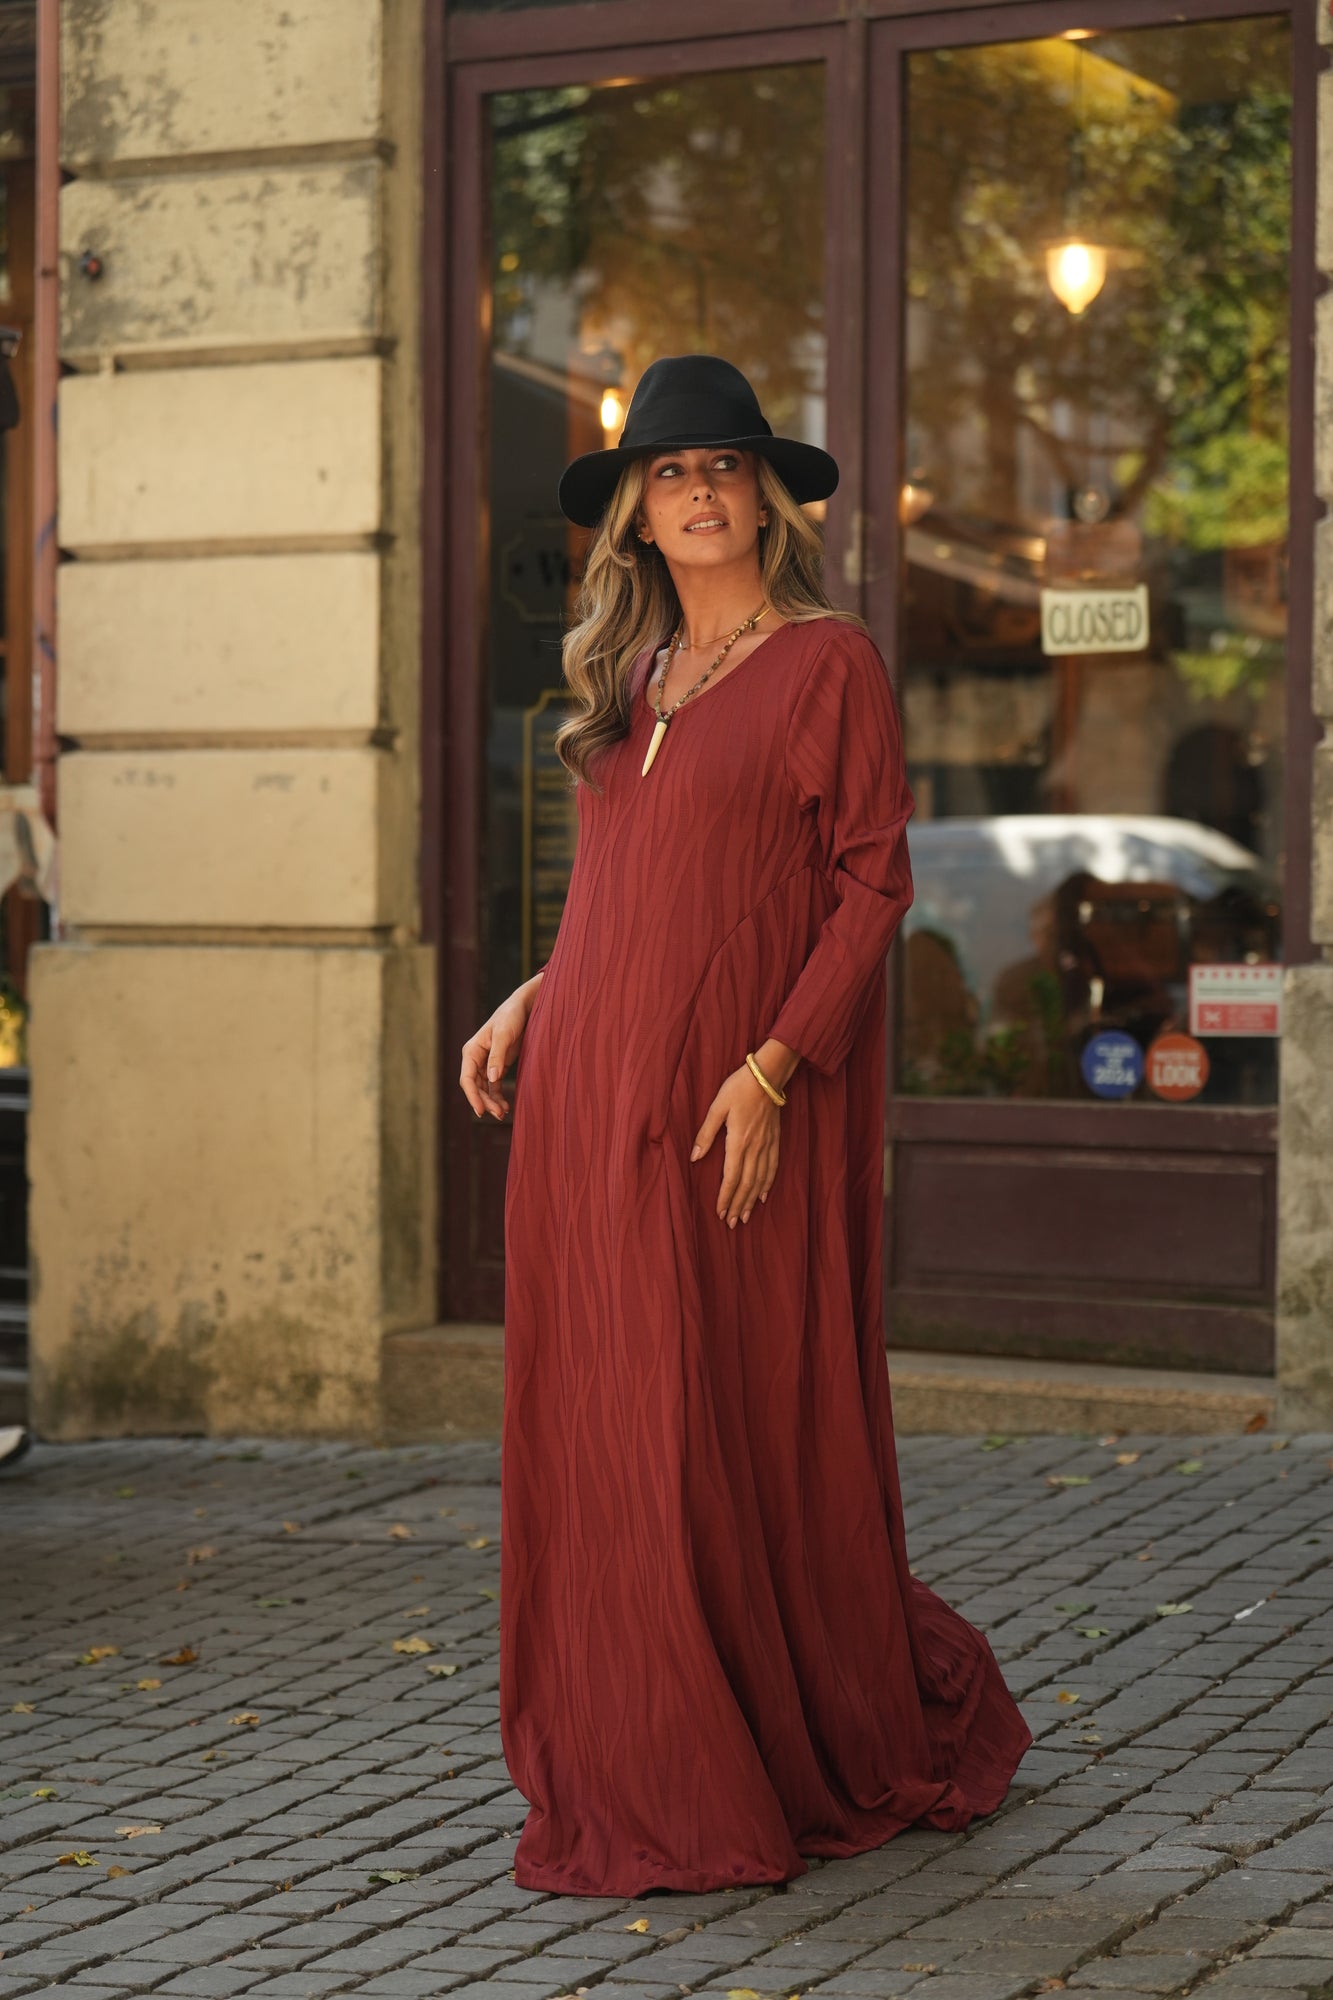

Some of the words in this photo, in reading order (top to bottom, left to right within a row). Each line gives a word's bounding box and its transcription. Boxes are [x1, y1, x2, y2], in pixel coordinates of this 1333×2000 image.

[1048, 600, 1143, 646] CLOSED
[1093, 1067, 1136, 1086] 2024
[1152, 1065, 1201, 1087] LOOK
